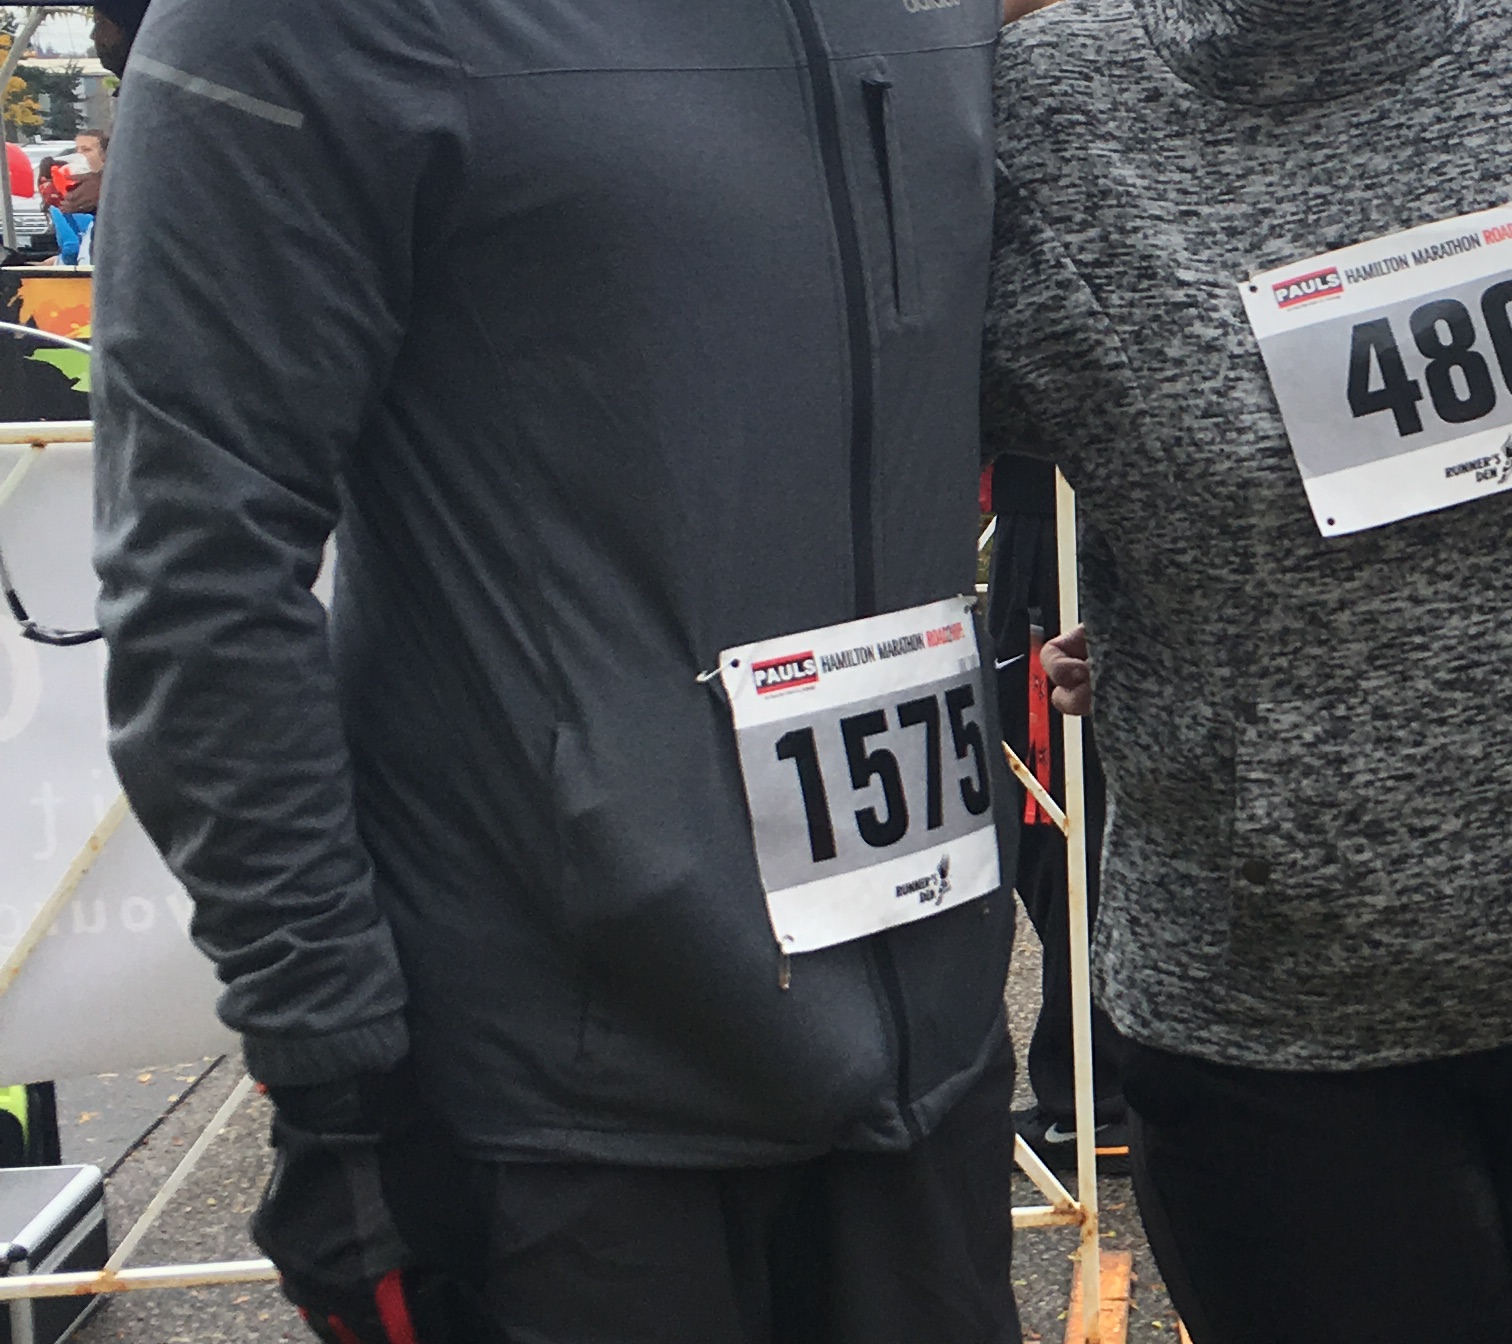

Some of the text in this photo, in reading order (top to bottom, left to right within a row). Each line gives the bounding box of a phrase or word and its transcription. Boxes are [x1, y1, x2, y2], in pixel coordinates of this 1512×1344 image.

[1275, 273, 1341, 302] PAULS
[1344, 253, 1410, 285] HAMILTON
[1411, 232, 1482, 267] MARATHON
[754, 659, 817, 688] PAULS
[820, 645, 877, 674] HAMILTON
[877, 632, 926, 660] MARATHON
[775, 683, 991, 863] 1575
